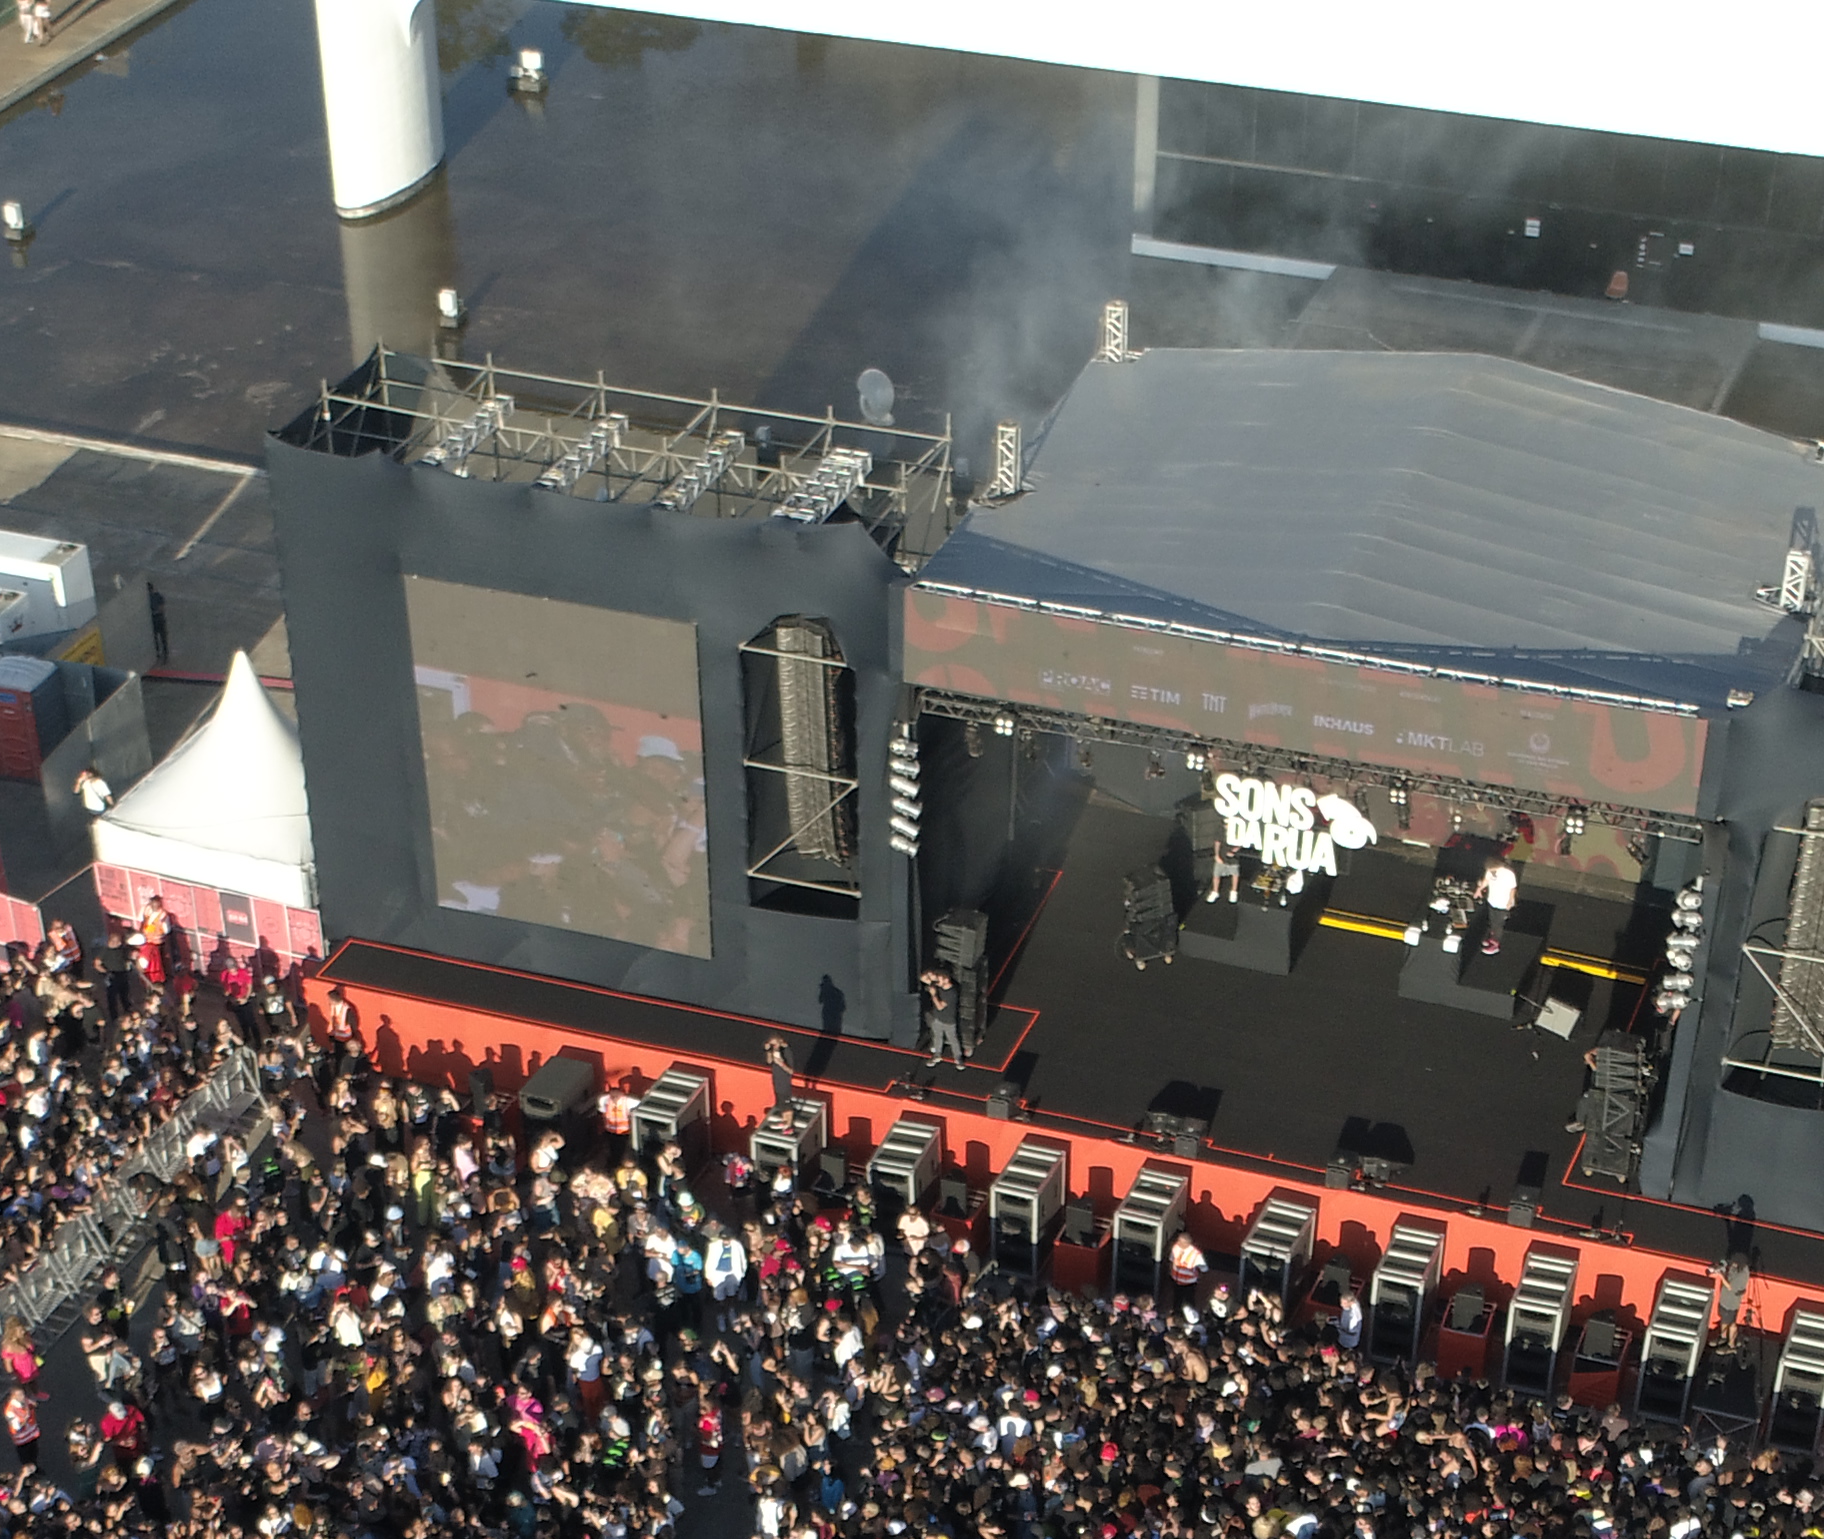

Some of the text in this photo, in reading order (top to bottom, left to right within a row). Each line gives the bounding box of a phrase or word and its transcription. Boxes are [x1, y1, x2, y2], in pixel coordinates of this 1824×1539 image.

[1150, 688, 1181, 705] TIM
[1202, 692, 1227, 713] TNT
[1214, 773, 1316, 831] SONS
[1225, 816, 1338, 877] DA RUA
